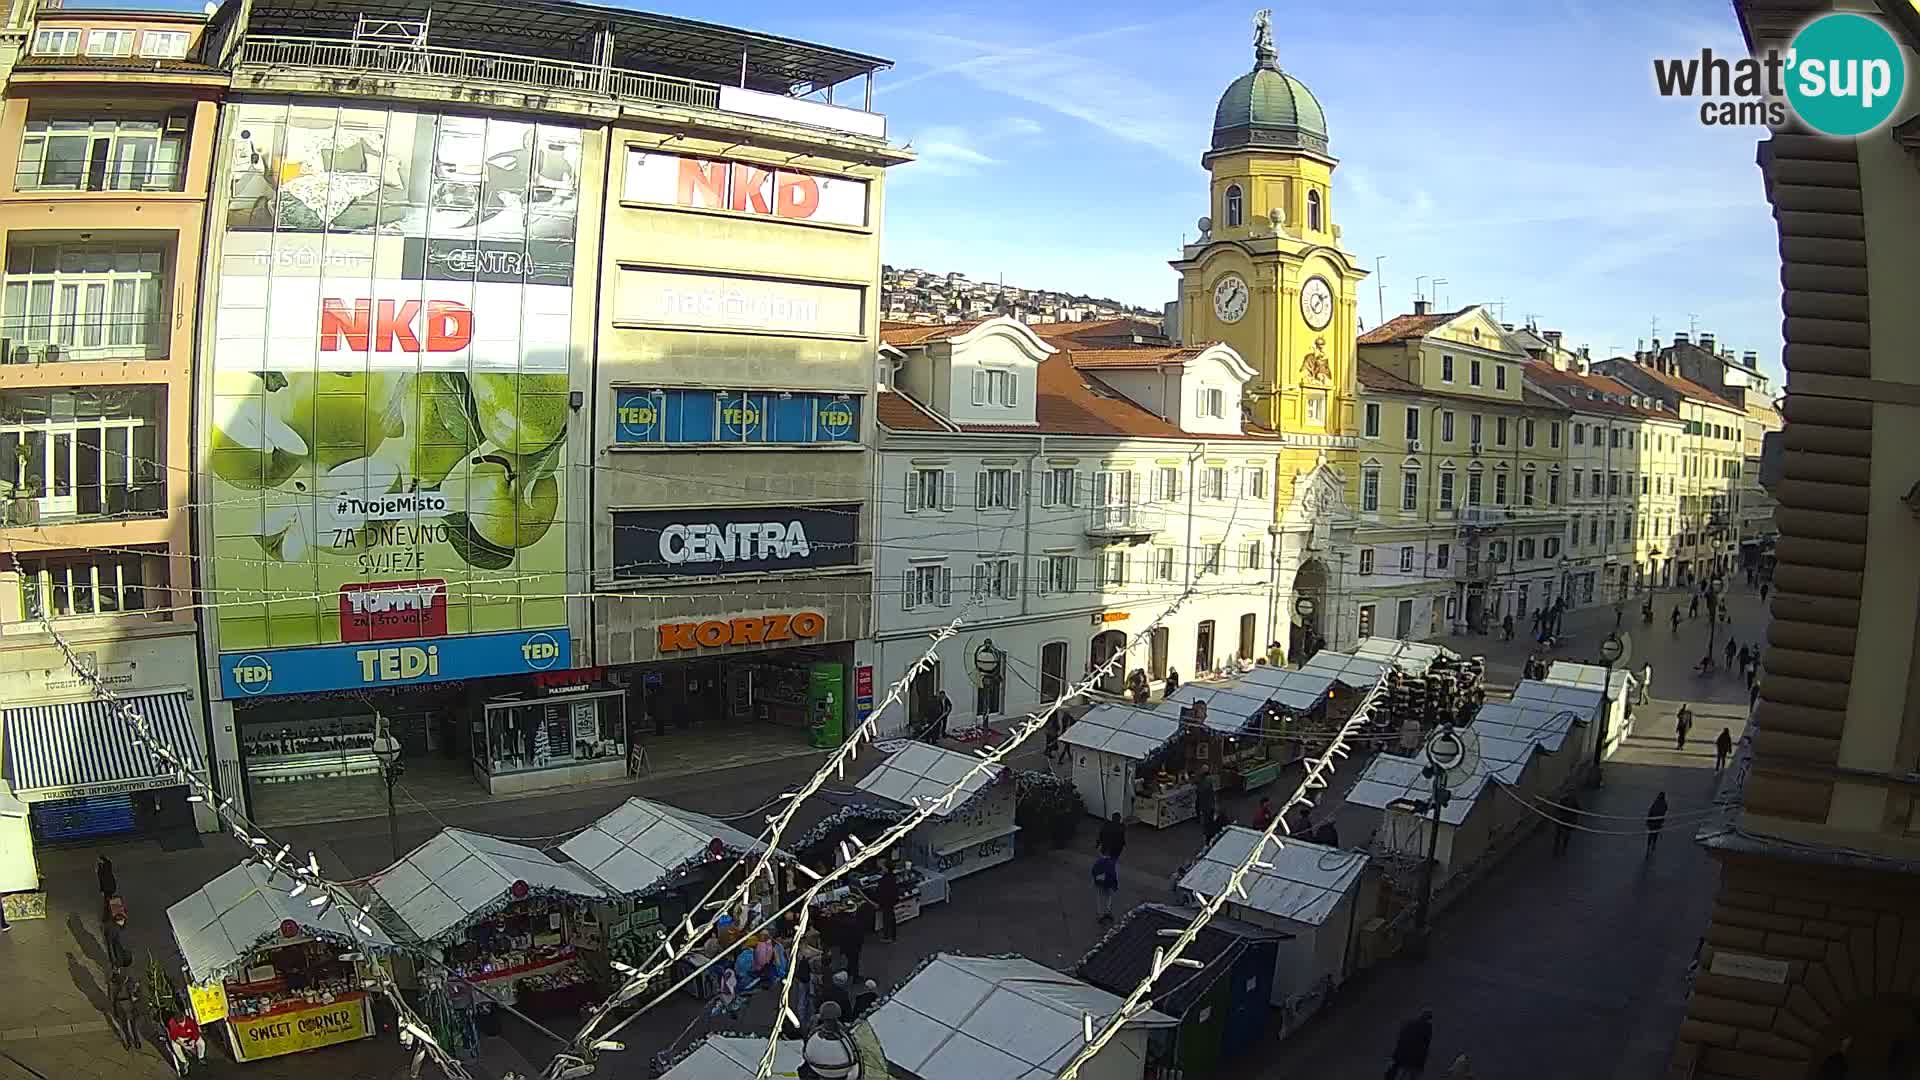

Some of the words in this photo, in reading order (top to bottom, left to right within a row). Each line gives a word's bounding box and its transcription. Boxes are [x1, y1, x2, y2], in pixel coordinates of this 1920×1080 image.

[677, 159, 819, 218] NKD
[447, 248, 535, 275] CENTRA
[320, 297, 475, 352] NKD
[618, 407, 657, 425] TEDi
[723, 408, 759, 425] TEDi
[820, 411, 852, 426] TEDi
[337, 495, 445, 516] #TvojeMisto
[332, 528, 357, 549] ZA
[366, 524, 449, 548] DNEVNO
[659, 520, 810, 564] CENTRA
[358, 547, 425, 575] SVJEŽE
[348, 585, 438, 614] TOMMY
[659, 612, 826, 652] KORZO
[357, 645, 439, 681] TEDi
[522, 642, 558, 660] TEDi
[233, 666, 272, 683] TEDi
[249, 1022, 293, 1042] SWEET
[297, 1010, 351, 1034] CORNER
